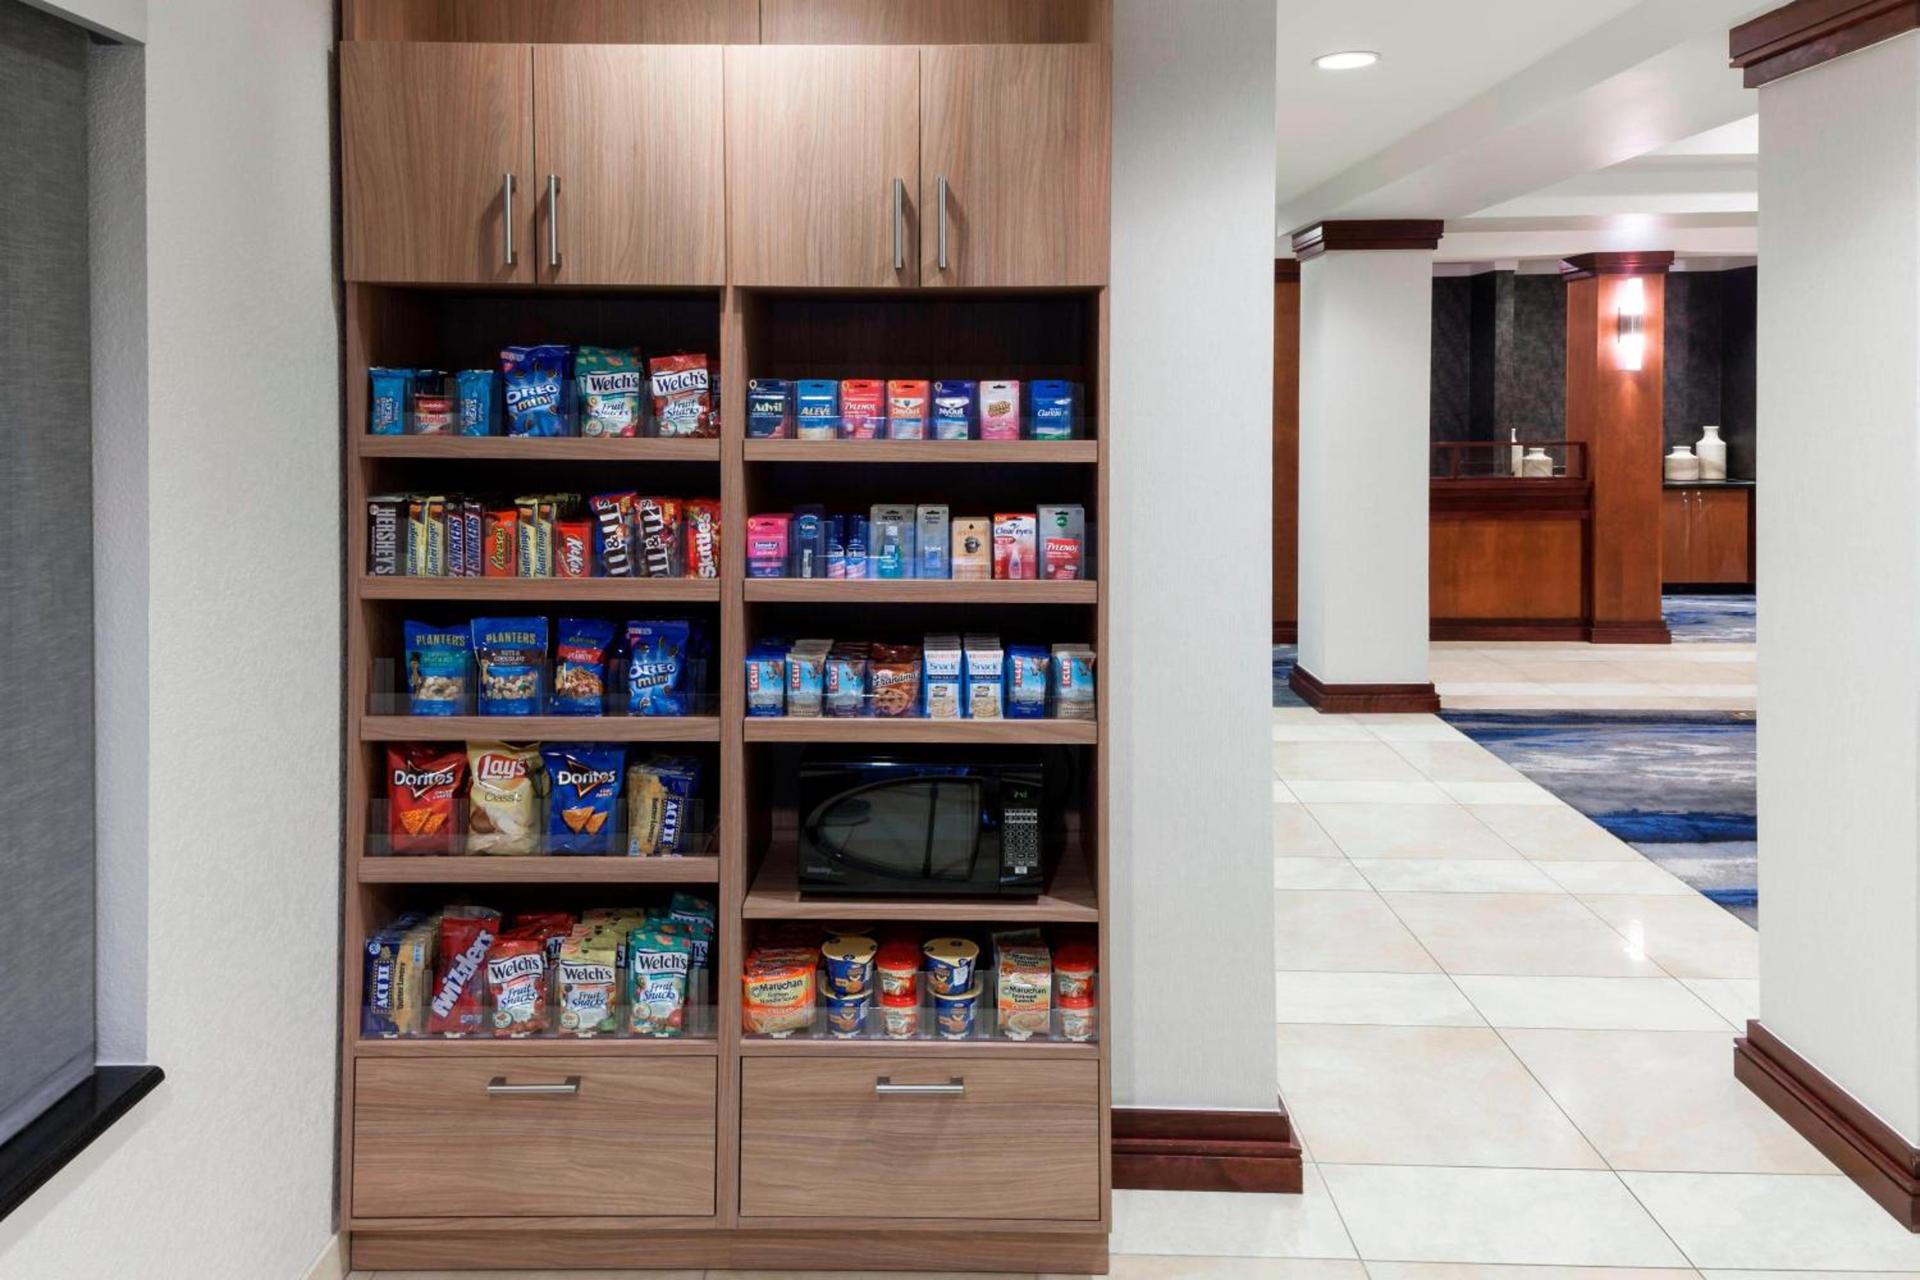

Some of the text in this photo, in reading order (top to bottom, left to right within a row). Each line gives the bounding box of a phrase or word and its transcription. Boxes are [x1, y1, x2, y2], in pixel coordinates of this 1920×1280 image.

[590, 373, 639, 392] Welch's
[655, 371, 707, 393] Welch's
[506, 384, 557, 405] OREO
[516, 394, 552, 412] mini
[673, 399, 696, 410] Fruit
[752, 401, 783, 413] Advil
[844, 401, 877, 411] TYLENOL
[666, 406, 700, 419] Snacks
[375, 508, 397, 575] HERSHEY'S
[428, 522, 440, 576] Butterfinger
[450, 515, 463, 573] SNICKERS
[465, 513, 481, 570] SNICKERS
[695, 513, 717, 577] Skittles
[415, 634, 466, 647] PLANTERS
[485, 632, 536, 645] PLANTERS
[628, 663, 676, 679] OREO
[394, 770, 454, 786] Doritos
[557, 770, 616, 786] Doritos
[665, 800, 678, 826] ACT
[490, 957, 540, 979] Welch's
[639, 954, 688, 970] Welch's
[563, 967, 613, 981] Welch's
[507, 984, 532, 997] Fruit
[650, 982, 673, 992] Fruit
[759, 978, 804, 992] Maruchan
[1009, 985, 1047, 995] Maruchan
[377, 982, 390, 1009] ACT
[577, 992, 601, 1000] Fruit
[643, 990, 676, 1000] Snacks
